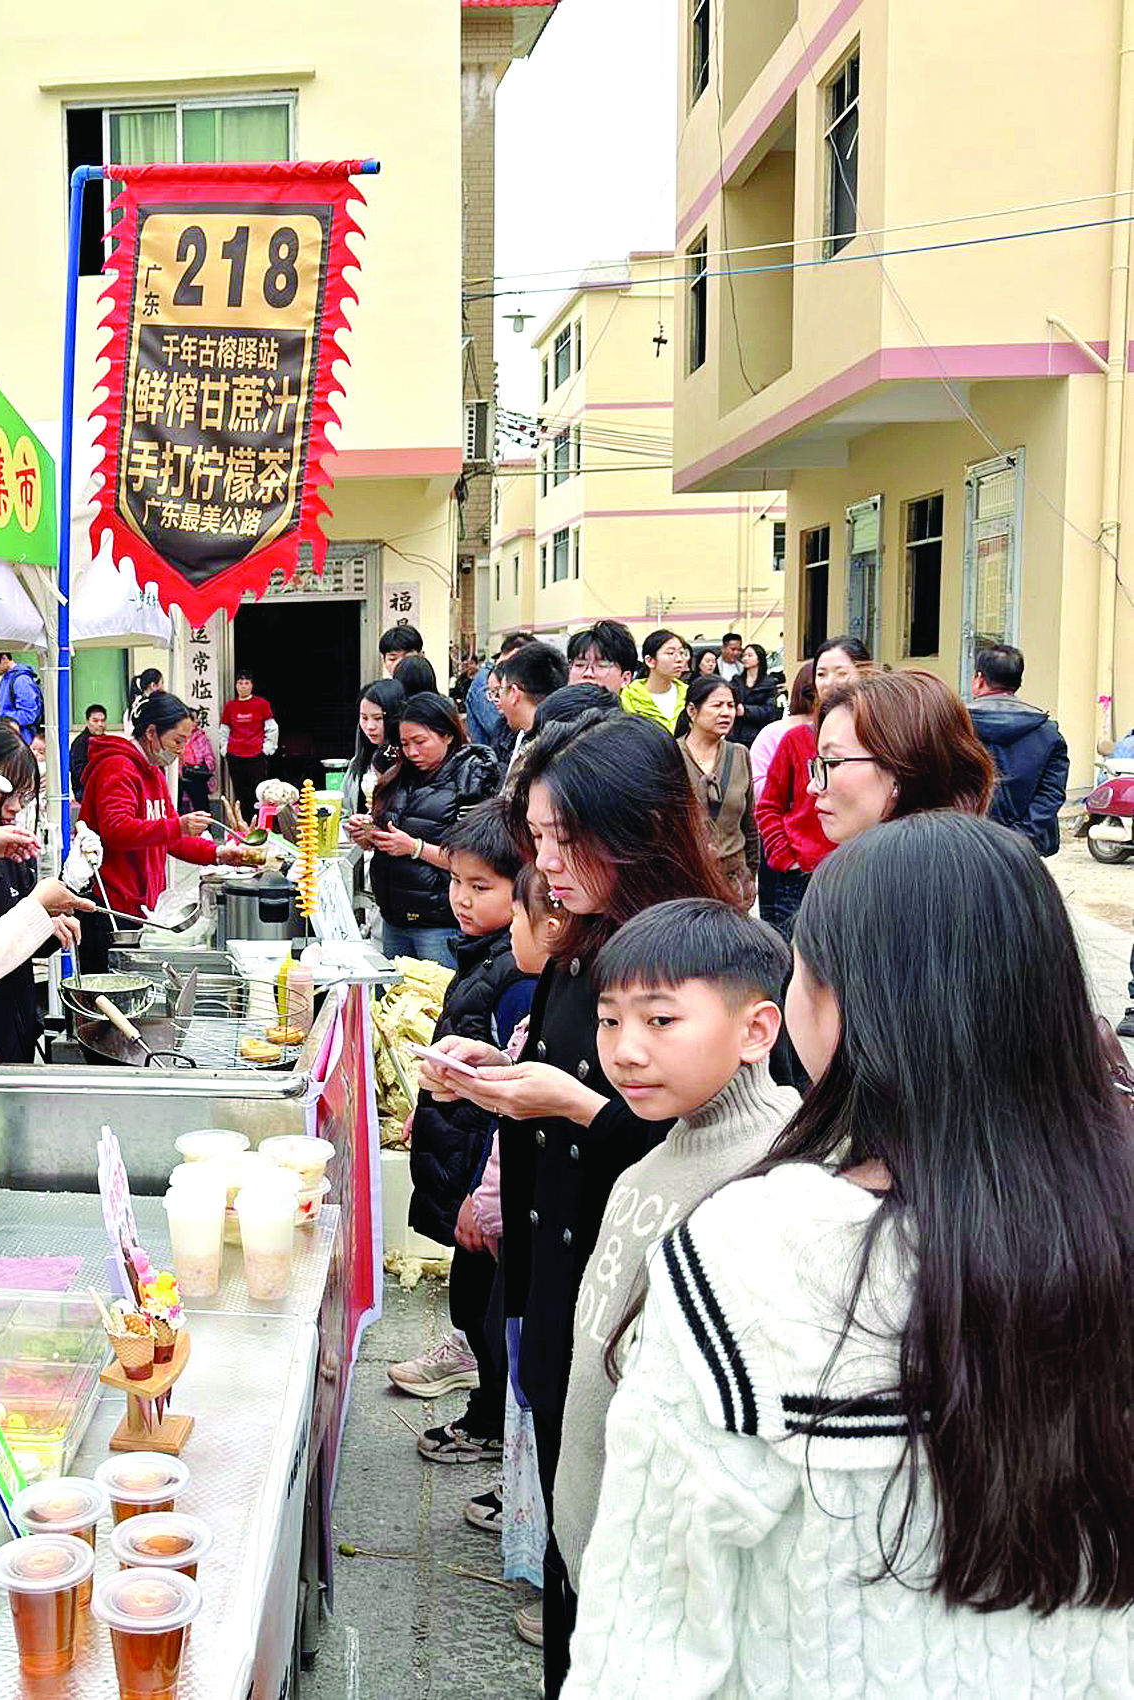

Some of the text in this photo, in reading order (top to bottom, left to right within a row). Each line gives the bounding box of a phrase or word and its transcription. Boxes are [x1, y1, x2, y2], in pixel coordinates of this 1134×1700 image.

[142, 263, 162, 317] 广东
[173, 226, 299, 308] 218
[162, 334, 279, 370] 千年古榕驿站
[135, 368, 298, 433] 鲜榨甘蔗汁
[128, 440, 291, 503] 手打柠檬茶
[143, 498, 263, 536] 广东最美公路
[596, 1235, 623, 1287] &
